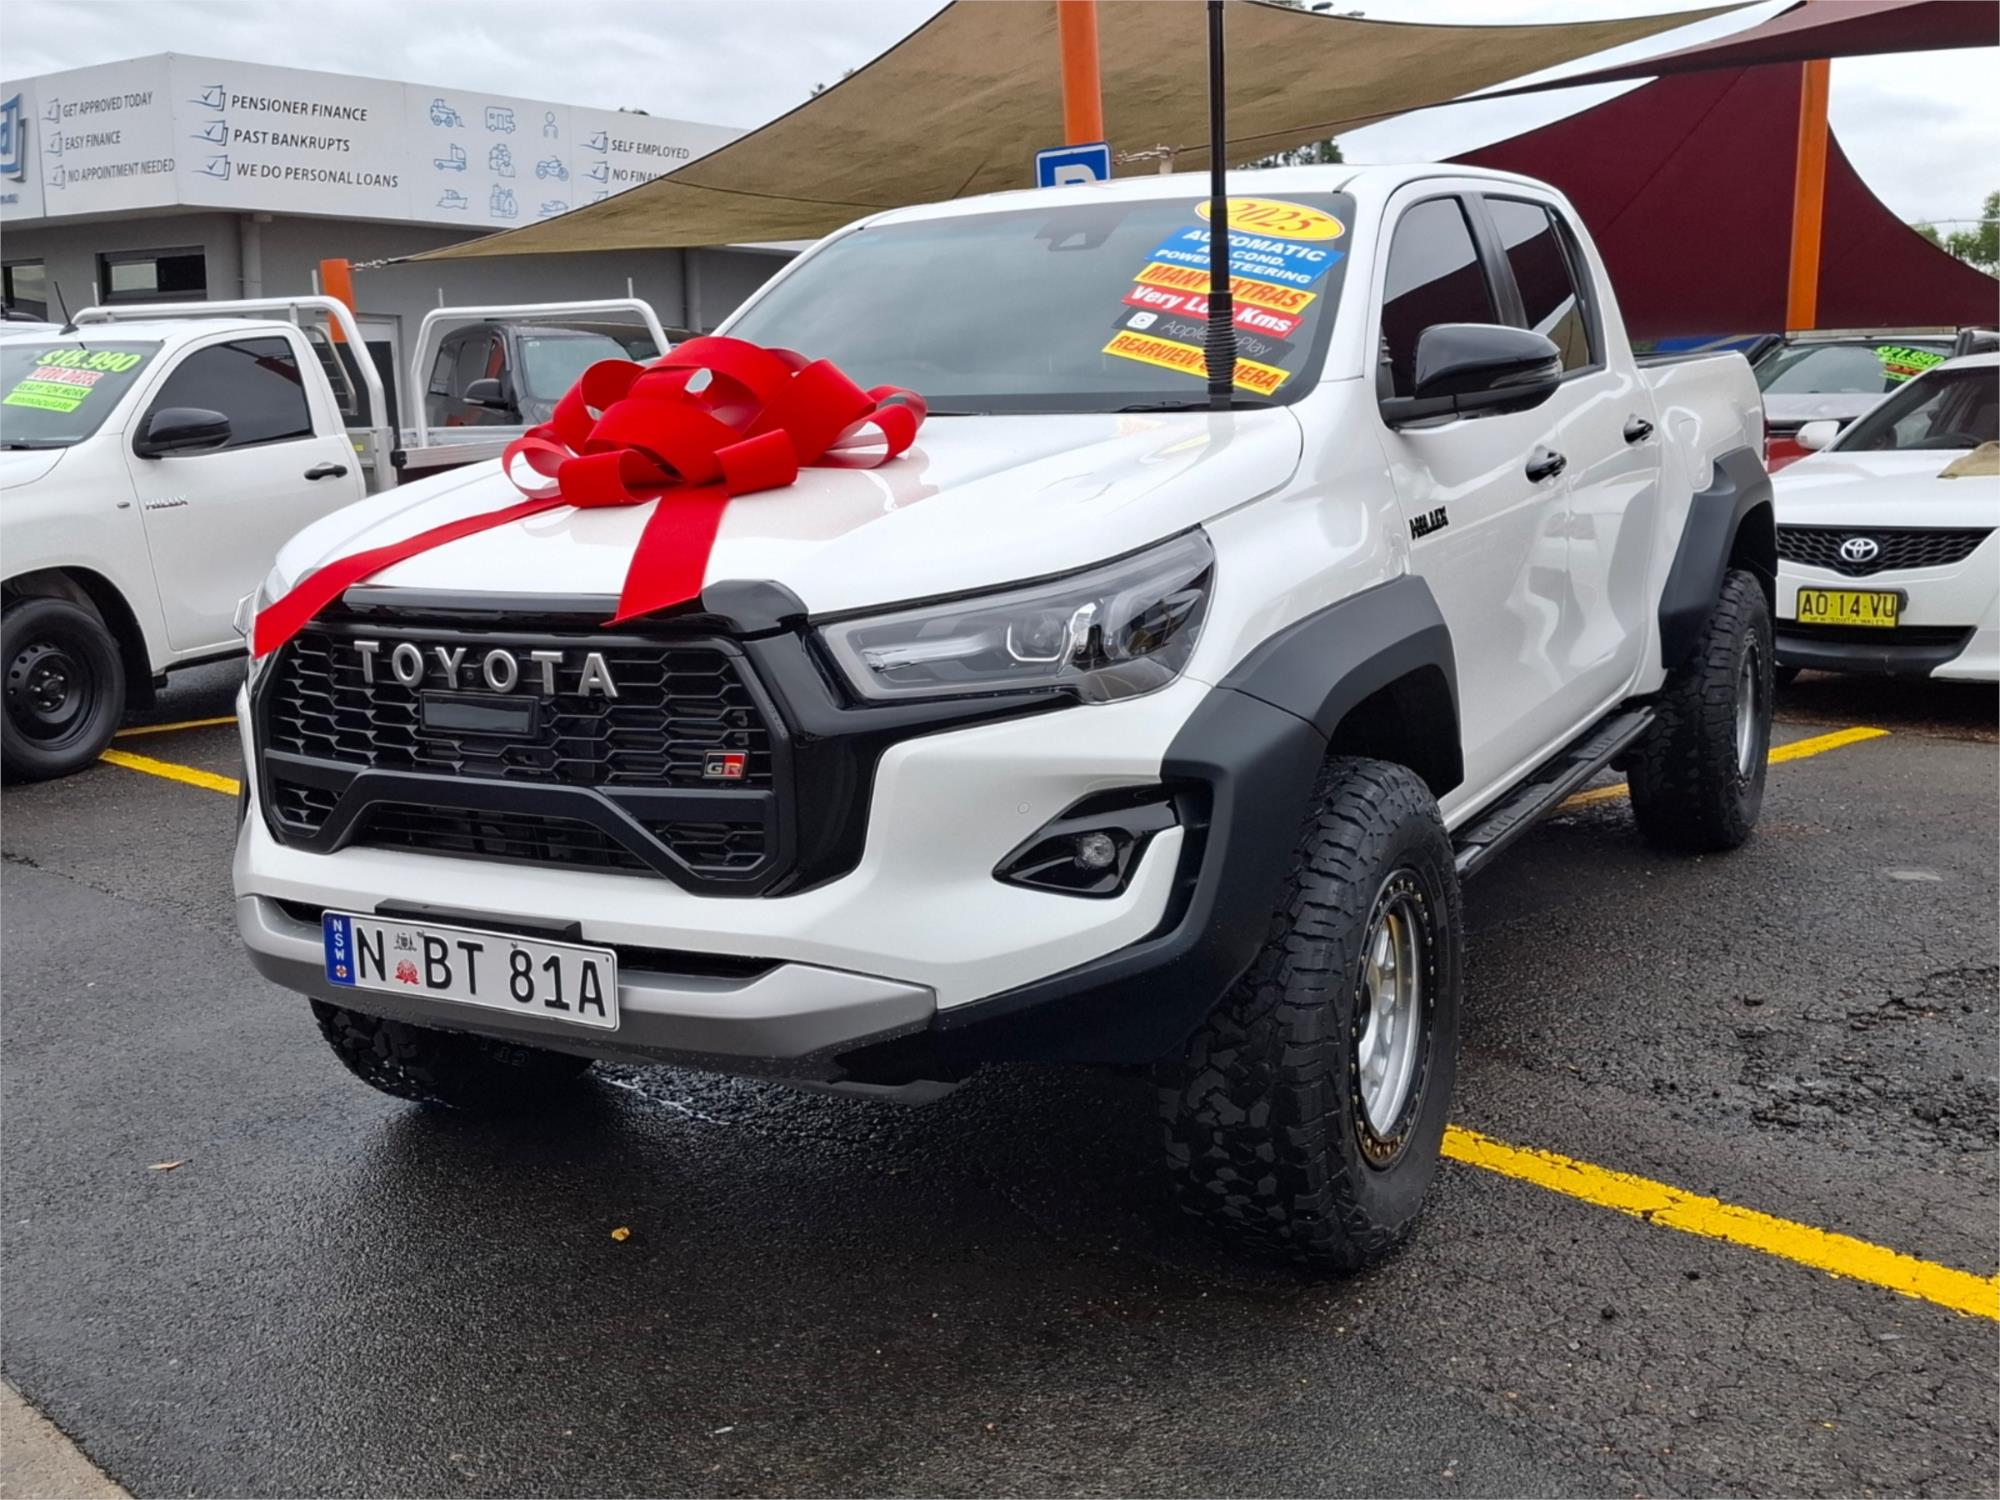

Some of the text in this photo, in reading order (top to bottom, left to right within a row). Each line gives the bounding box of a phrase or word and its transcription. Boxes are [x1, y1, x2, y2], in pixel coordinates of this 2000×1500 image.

[63, 91, 153, 118] GET APPROVED TODAY
[231, 94, 368, 122] PENSIONER FINANCE
[65, 130, 121, 150] EASY FINANCE
[233, 129, 351, 152] PAST BANKRUPTS
[611, 139, 690, 159] SELF EMPLOYED
[67, 158, 175, 183] NO APPOINTMENT NEEDED
[236, 162, 399, 188] WE DO PERSONAL LOANS
[612, 168, 629, 181] NO
[1182, 230, 1327, 262] AOMATIC
[1232, 250, 1286, 267] COND.
[1141, 264, 1211, 290] MANY
[1229, 260, 1312, 284] TEERING
[1131, 286, 1179, 310] Very
[1235, 306, 1293, 333] Kms
[1110, 335, 1204, 366] REARVIEW
[1408, 505, 1449, 540] HILUX
[354, 639, 618, 698] TOYOTA
[706, 761, 743, 777] GR
[333, 918, 345, 961] NSW
[509, 948, 606, 1018] 81A
